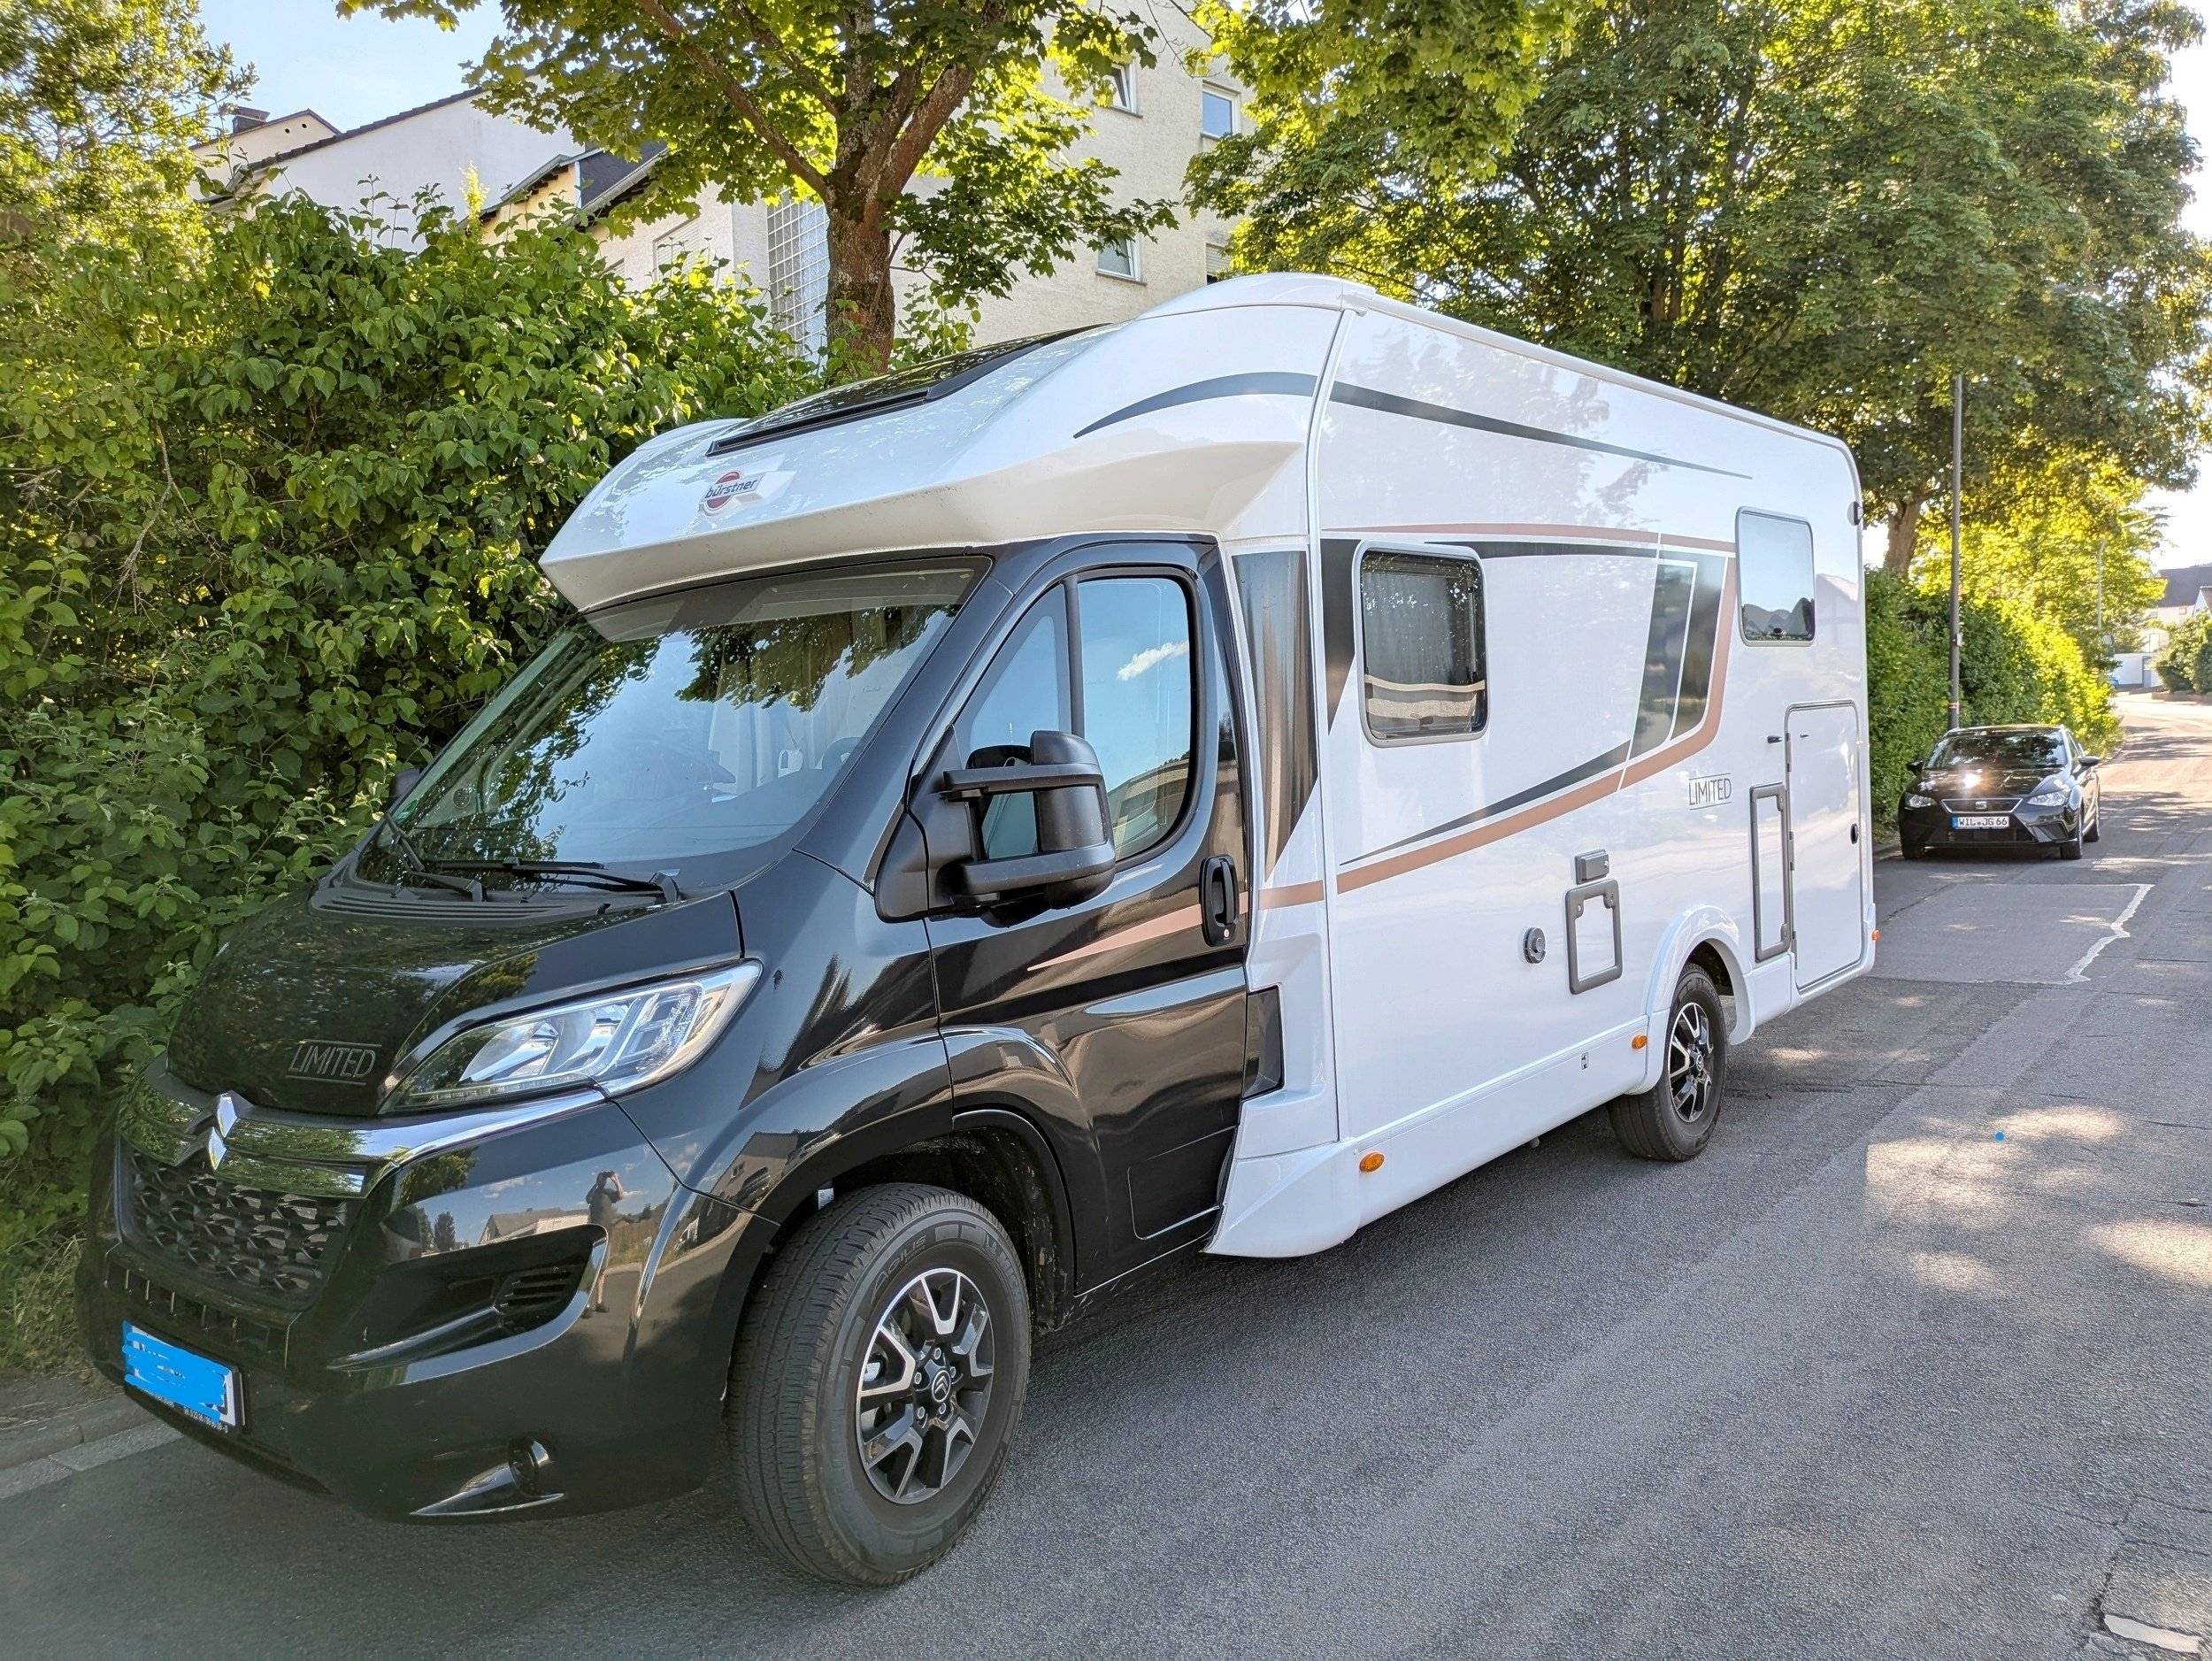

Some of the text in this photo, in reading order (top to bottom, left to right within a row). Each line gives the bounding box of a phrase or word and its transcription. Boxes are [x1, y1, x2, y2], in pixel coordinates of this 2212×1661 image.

[704, 479, 758, 499] bürstner
[1688, 778, 1732, 806] LIMITED
[288, 1044, 376, 1078] LIMITED
